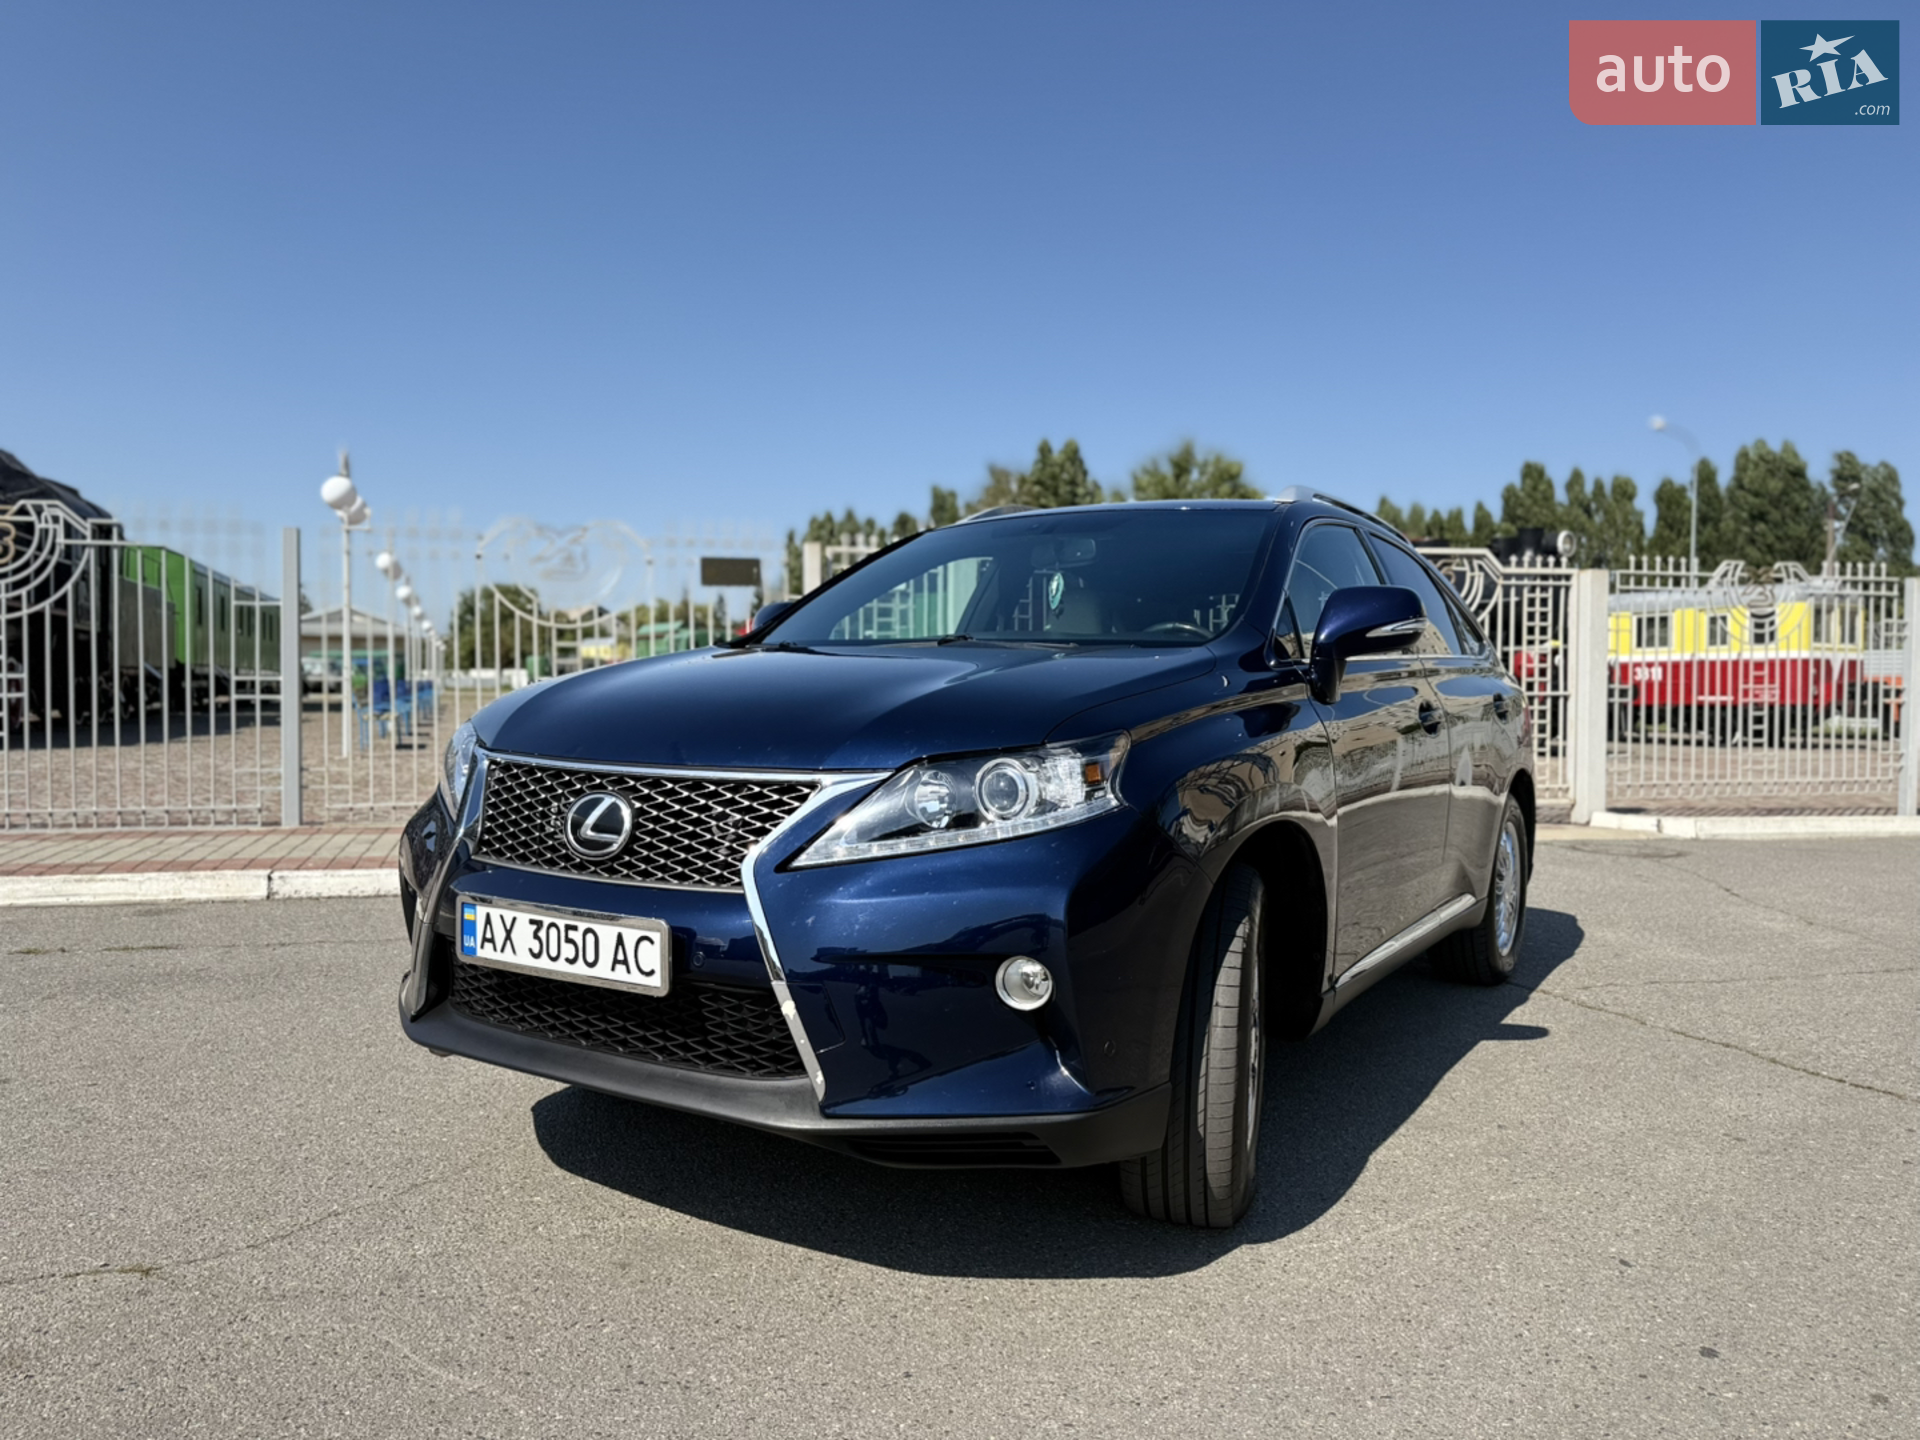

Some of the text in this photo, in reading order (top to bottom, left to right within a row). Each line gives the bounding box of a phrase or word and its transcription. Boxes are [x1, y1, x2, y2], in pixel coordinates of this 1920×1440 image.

[463, 934, 476, 948] UA
[480, 911, 656, 977] AX 3050 AC
